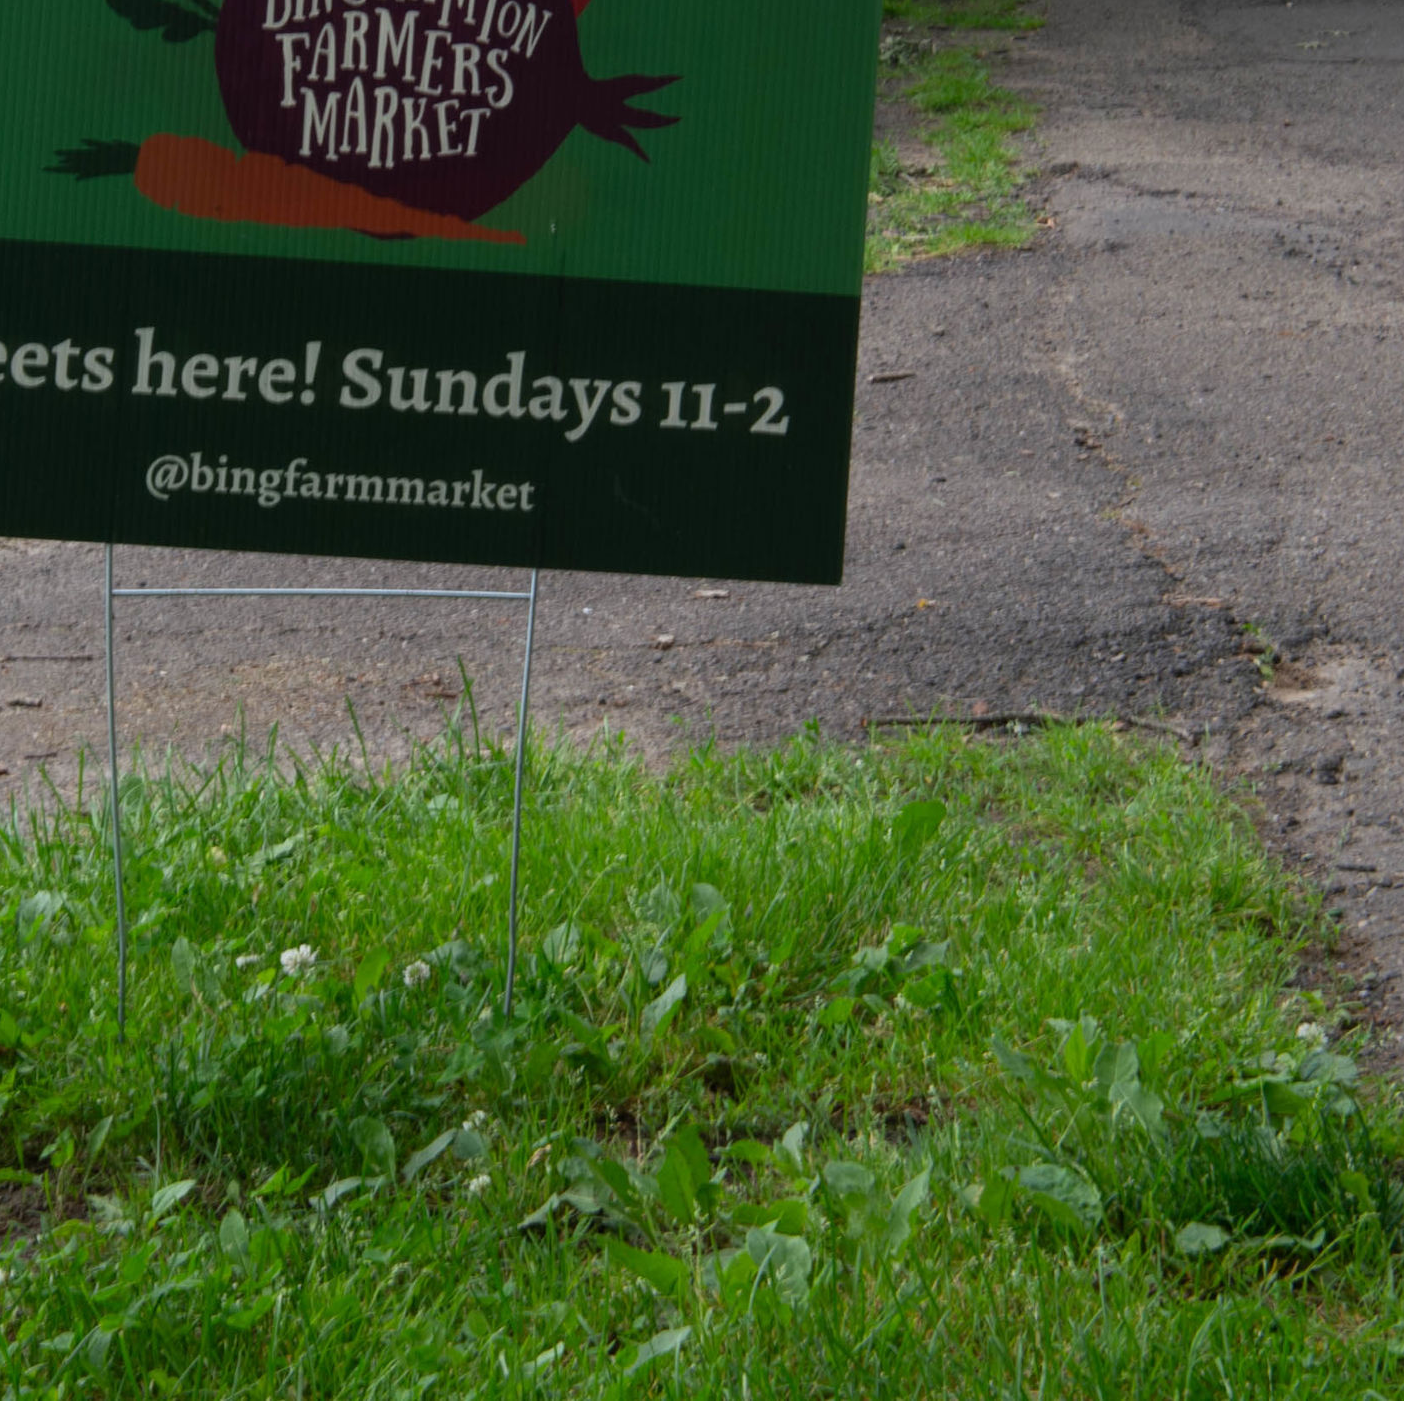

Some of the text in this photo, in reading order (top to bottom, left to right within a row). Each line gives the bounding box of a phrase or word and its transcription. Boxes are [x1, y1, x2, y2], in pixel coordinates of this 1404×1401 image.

[275, 7, 514, 108] FARMERS
[299, 76, 491, 169] MARKET
[131, 326, 323, 406] here!
[339, 347, 643, 443] Sundays
[659, 380, 791, 437] 11-2
[145, 452, 535, 512] @bingfarmmarket
